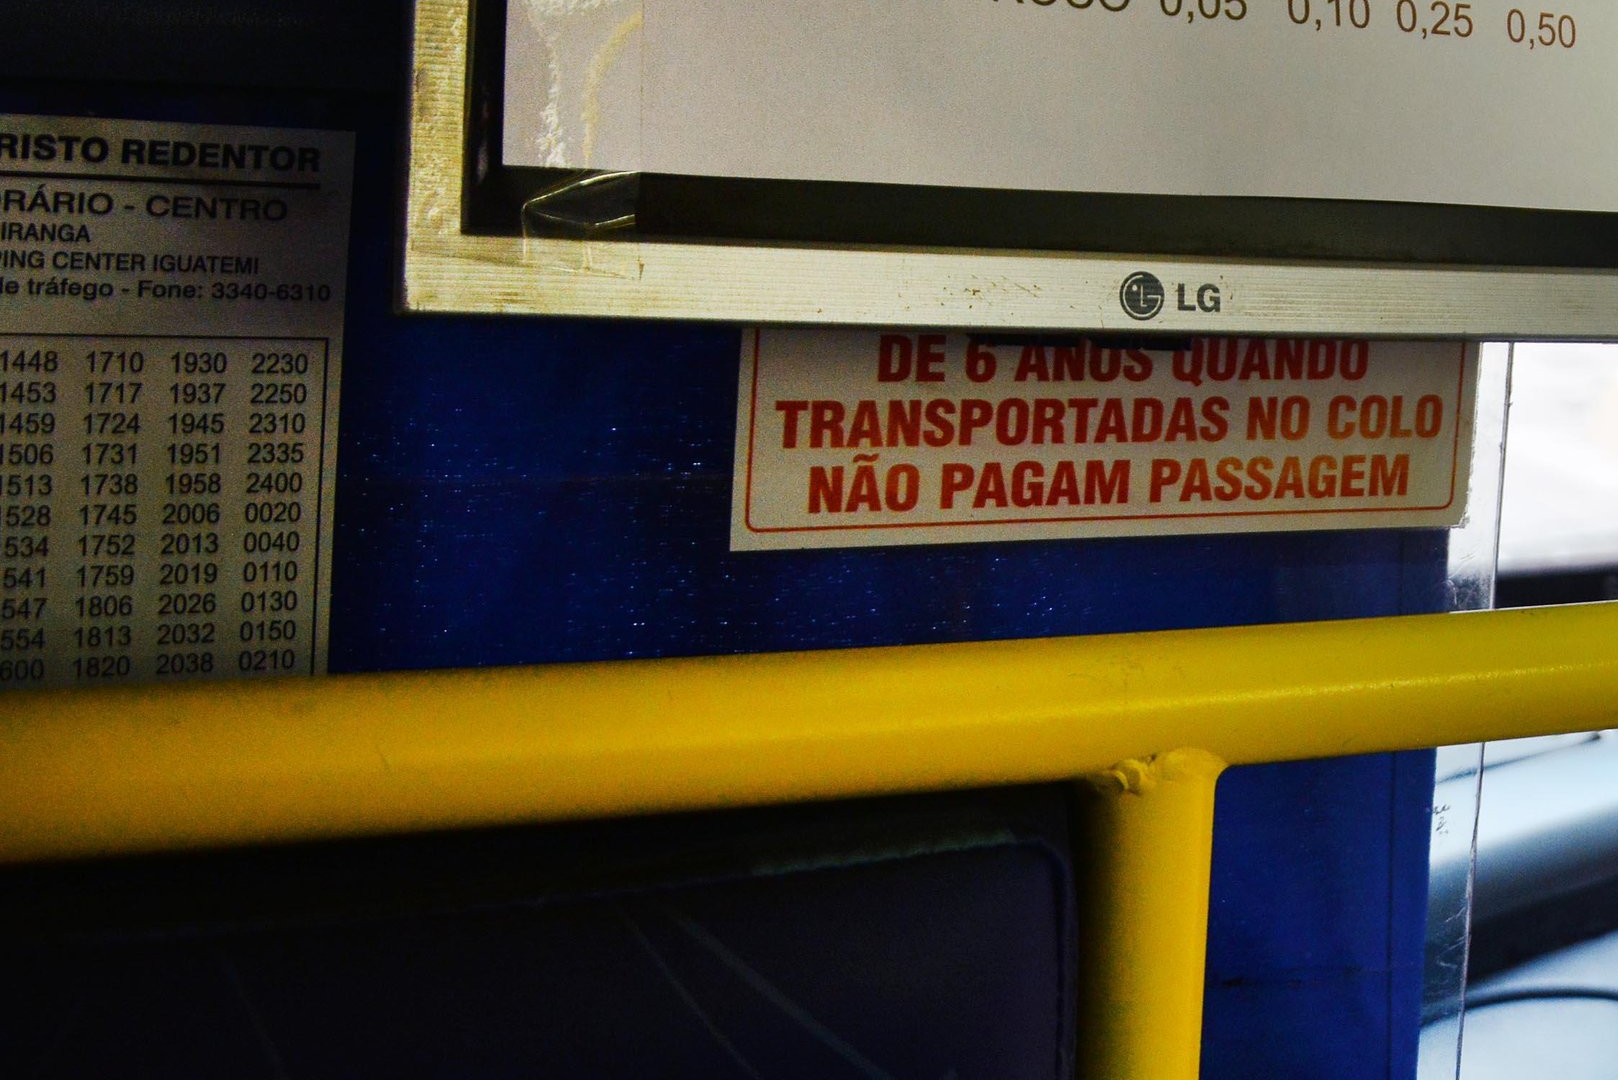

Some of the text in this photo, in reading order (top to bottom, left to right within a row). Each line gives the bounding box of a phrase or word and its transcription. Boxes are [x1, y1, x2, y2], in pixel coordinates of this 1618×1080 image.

[1507, 8, 1577, 51] 0,50
[121, 138, 320, 173] REDENTOR
[0, 184, 114, 216] RÁRIO
[146, 195, 288, 221] CENTRO
[52, 252, 146, 272] CENTER
[153, 254, 259, 275] IGUATEMI
[28, 278, 113, 301] tráfego
[138, 280, 203, 300] Fone:
[212, 283, 331, 302] 3340-6310
[1177, 283, 1221, 313] LG
[1, 351, 309, 375] 1448 1710 1930 2230
[877, 334, 1369, 387] DE 6 ANOS QUANDO
[0, 383, 307, 405] 1453 1717 1937 2250
[83, 414, 141, 435] 1724
[168, 413, 224, 435] 1945
[248, 413, 306, 435] 2310
[776, 394, 1443, 449] TRANSPORTADAS NO COLO
[82, 443, 139, 466] 1731
[167, 443, 222, 466] 1951
[247, 443, 304, 465] 2335
[80, 474, 138, 496] 1738
[165, 473, 222, 495] 1958
[245, 472, 303, 494] 2400
[807, 452, 1410, 515] NÃO PAGAM PASSAGEM
[79, 505, 138, 526] 1745
[162, 503, 221, 526] 2006
[245, 502, 302, 524] 0020
[78, 535, 136, 557] 1752
[160, 533, 219, 556] 2013
[243, 532, 300, 553] 0040
[76, 565, 135, 587] 1759
[159, 563, 218, 586] 2019
[242, 561, 299, 584] 0110
[74, 596, 133, 618] 1806
[158, 593, 216, 616] 2026
[240, 591, 298, 613] 0130
[73, 626, 132, 648] 1813
[156, 623, 215, 646] 2032
[239, 620, 297, 643] 0150
[71, 656, 131, 679] 1820
[155, 653, 214, 676] 2038
[238, 650, 296, 672] 0210
